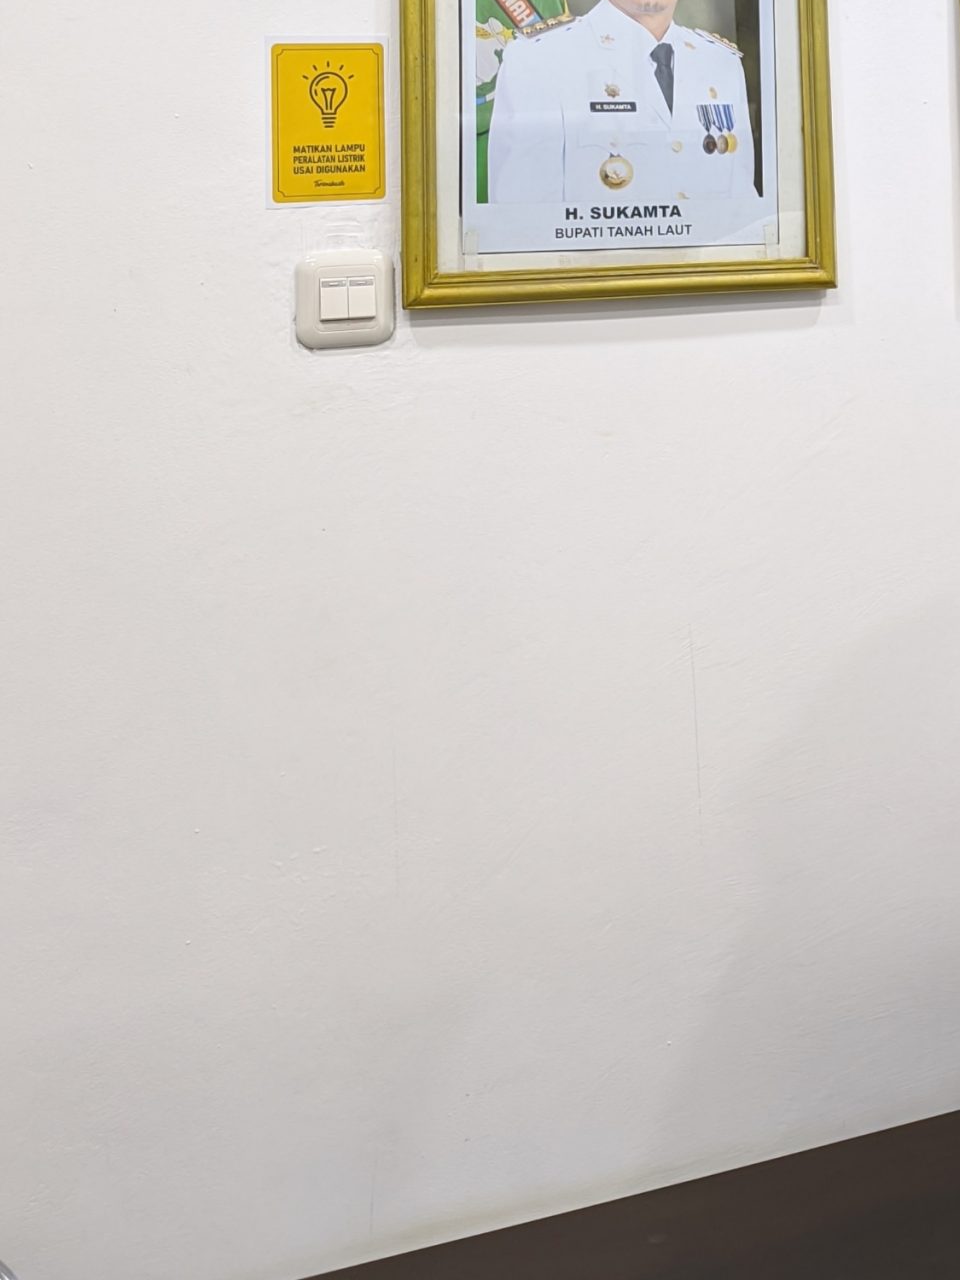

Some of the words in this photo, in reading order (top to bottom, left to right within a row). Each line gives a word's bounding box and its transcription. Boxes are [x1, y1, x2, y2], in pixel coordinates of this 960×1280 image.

[602, 103, 633, 111] SUKAMTA
[293, 144, 332, 154] MATIKAN
[335, 143, 365, 153] LAMPU
[293, 155, 336, 164] PERALATAN
[338, 154, 365, 164] LISTRIK
[293, 166, 313, 175] USAI
[316, 165, 366, 174] DIGUNAKAN
[565, 207, 584, 220] H.
[590, 205, 682, 220] SUKAMTA
[555, 226, 603, 239] BUPATI
[607, 225, 653, 238] TANAH
[658, 224, 692, 236] LAUT
